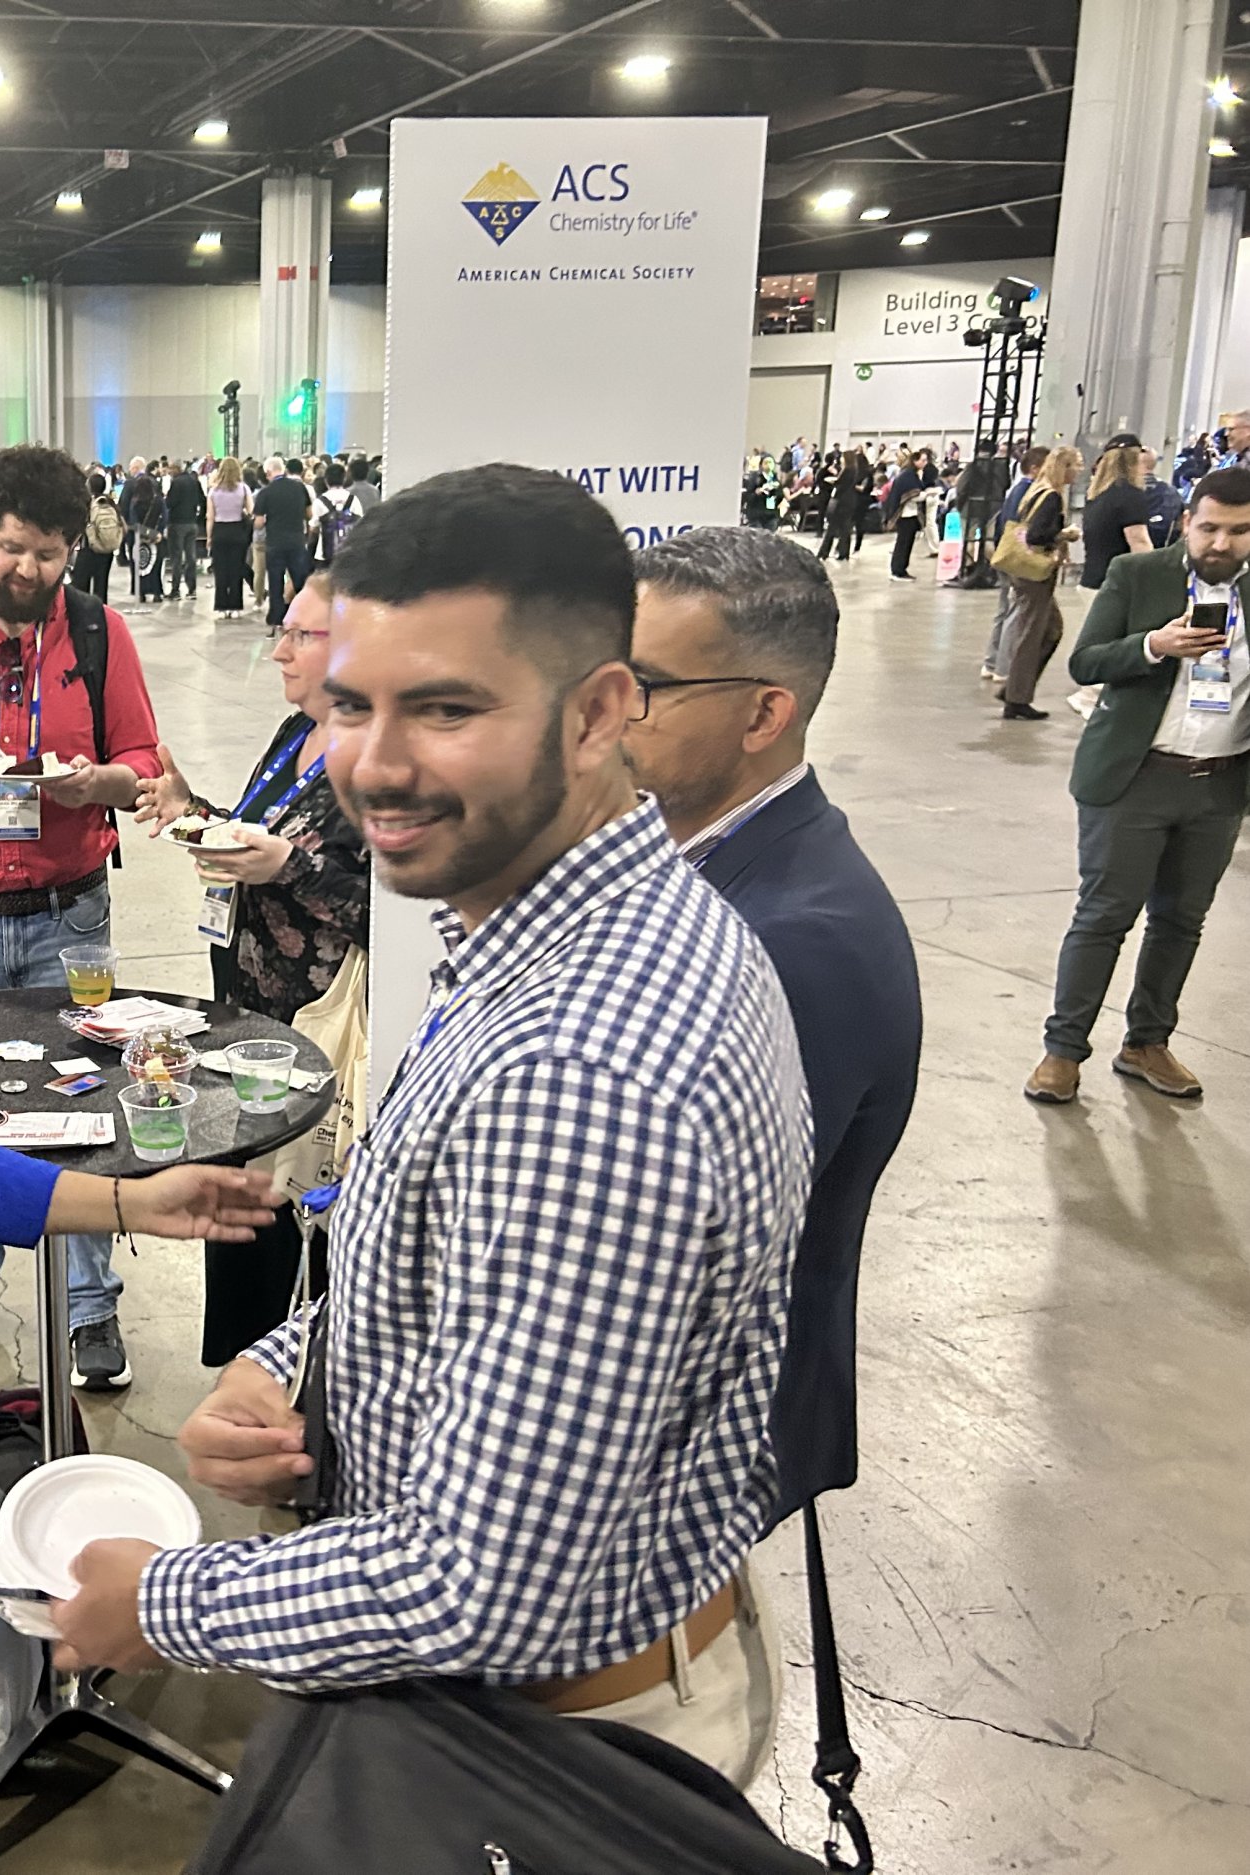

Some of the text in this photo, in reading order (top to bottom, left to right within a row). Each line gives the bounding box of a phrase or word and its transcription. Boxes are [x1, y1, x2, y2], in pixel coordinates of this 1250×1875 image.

[551, 164, 630, 202] ACS
[550, 212, 635, 236] Chemistry
[635, 211, 661, 231] for
[886, 291, 977, 312] Building
[884, 315, 941, 336] Level
[946, 314, 959, 332] 3
[619, 465, 699, 494] WITH
